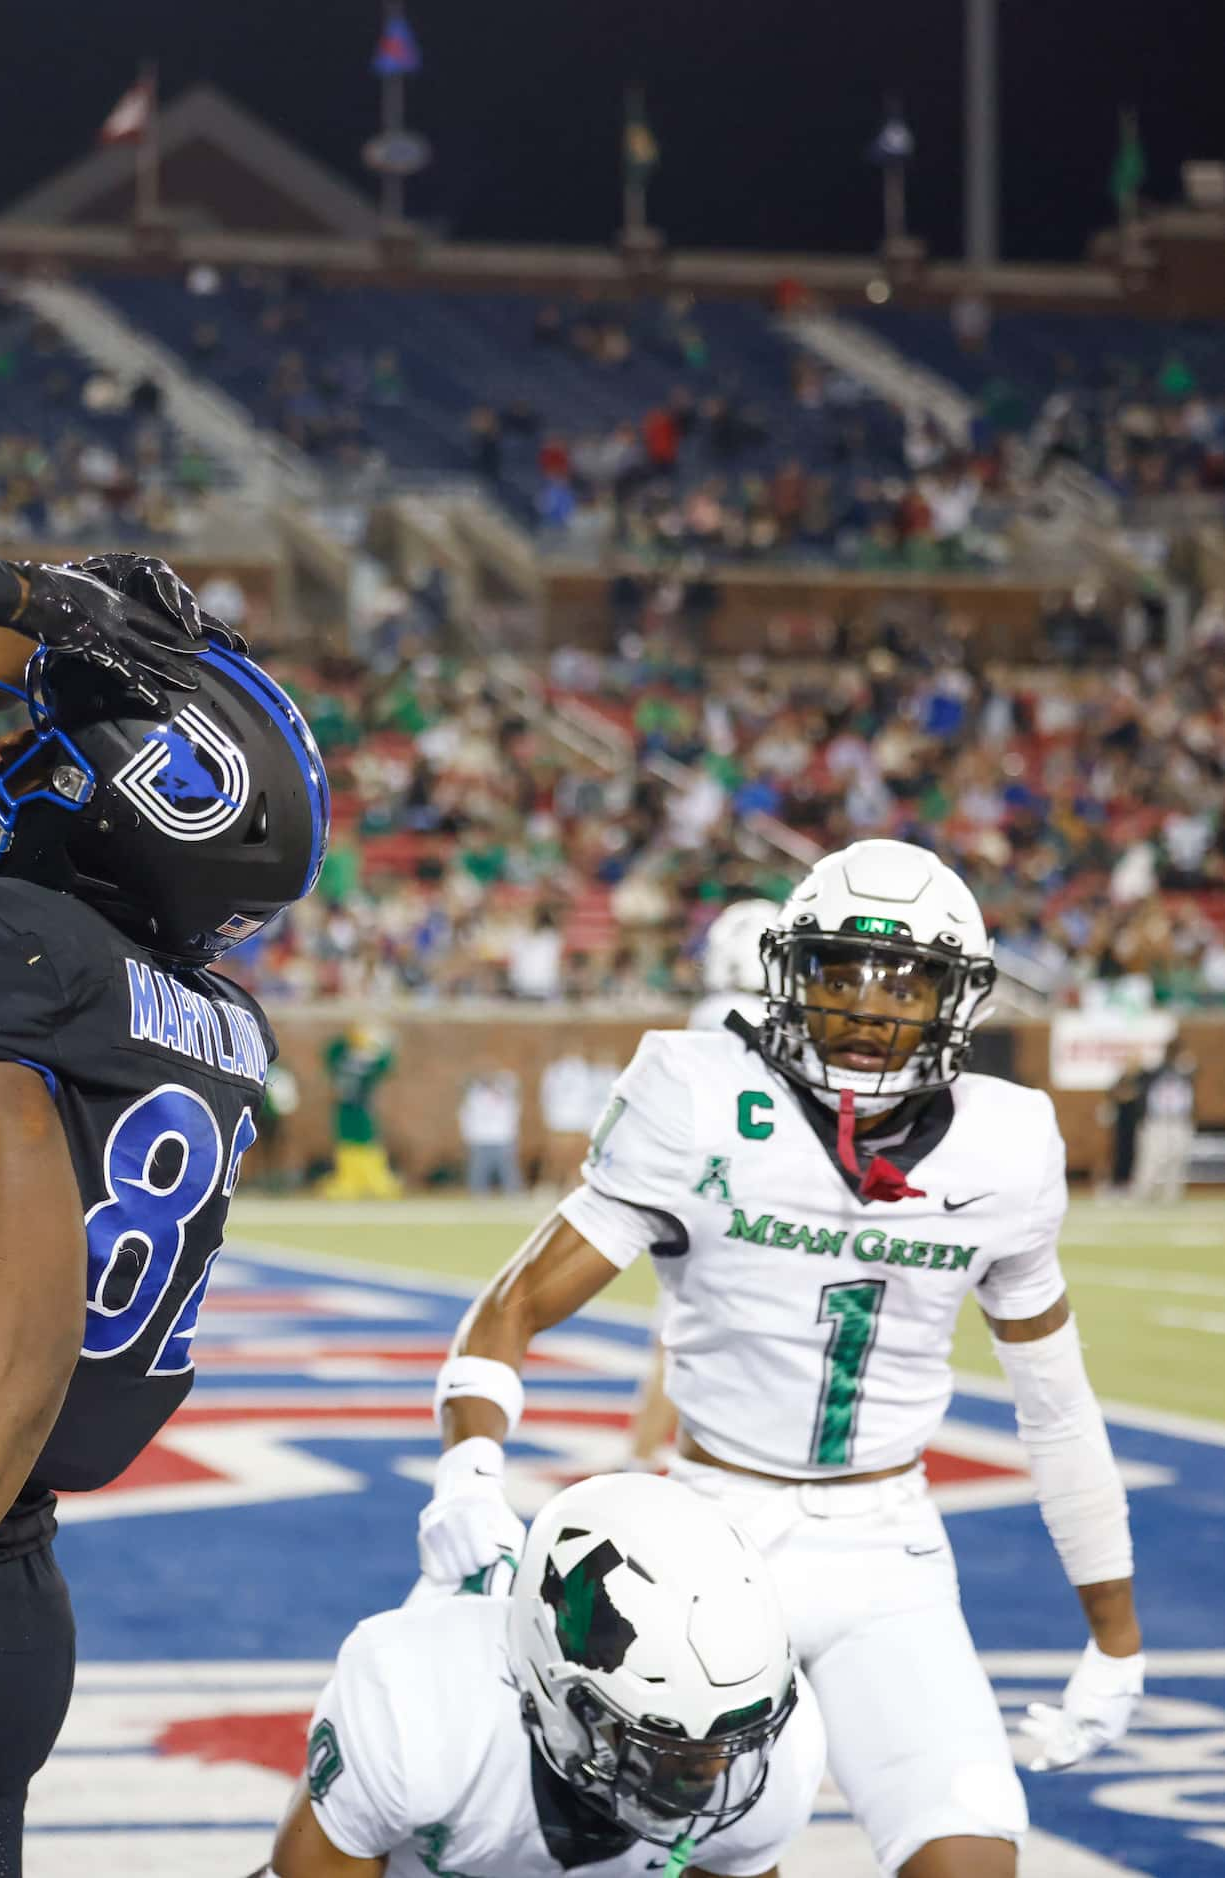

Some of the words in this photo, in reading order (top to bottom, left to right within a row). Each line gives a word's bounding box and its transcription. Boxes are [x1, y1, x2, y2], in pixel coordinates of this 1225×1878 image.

[125, 957, 268, 1087] MARYLAND
[737, 1090, 774, 1140] C
[725, 1208, 848, 1259] MEAN
[853, 1229, 980, 1272] GREEN
[808, 1279, 887, 1467] 1
